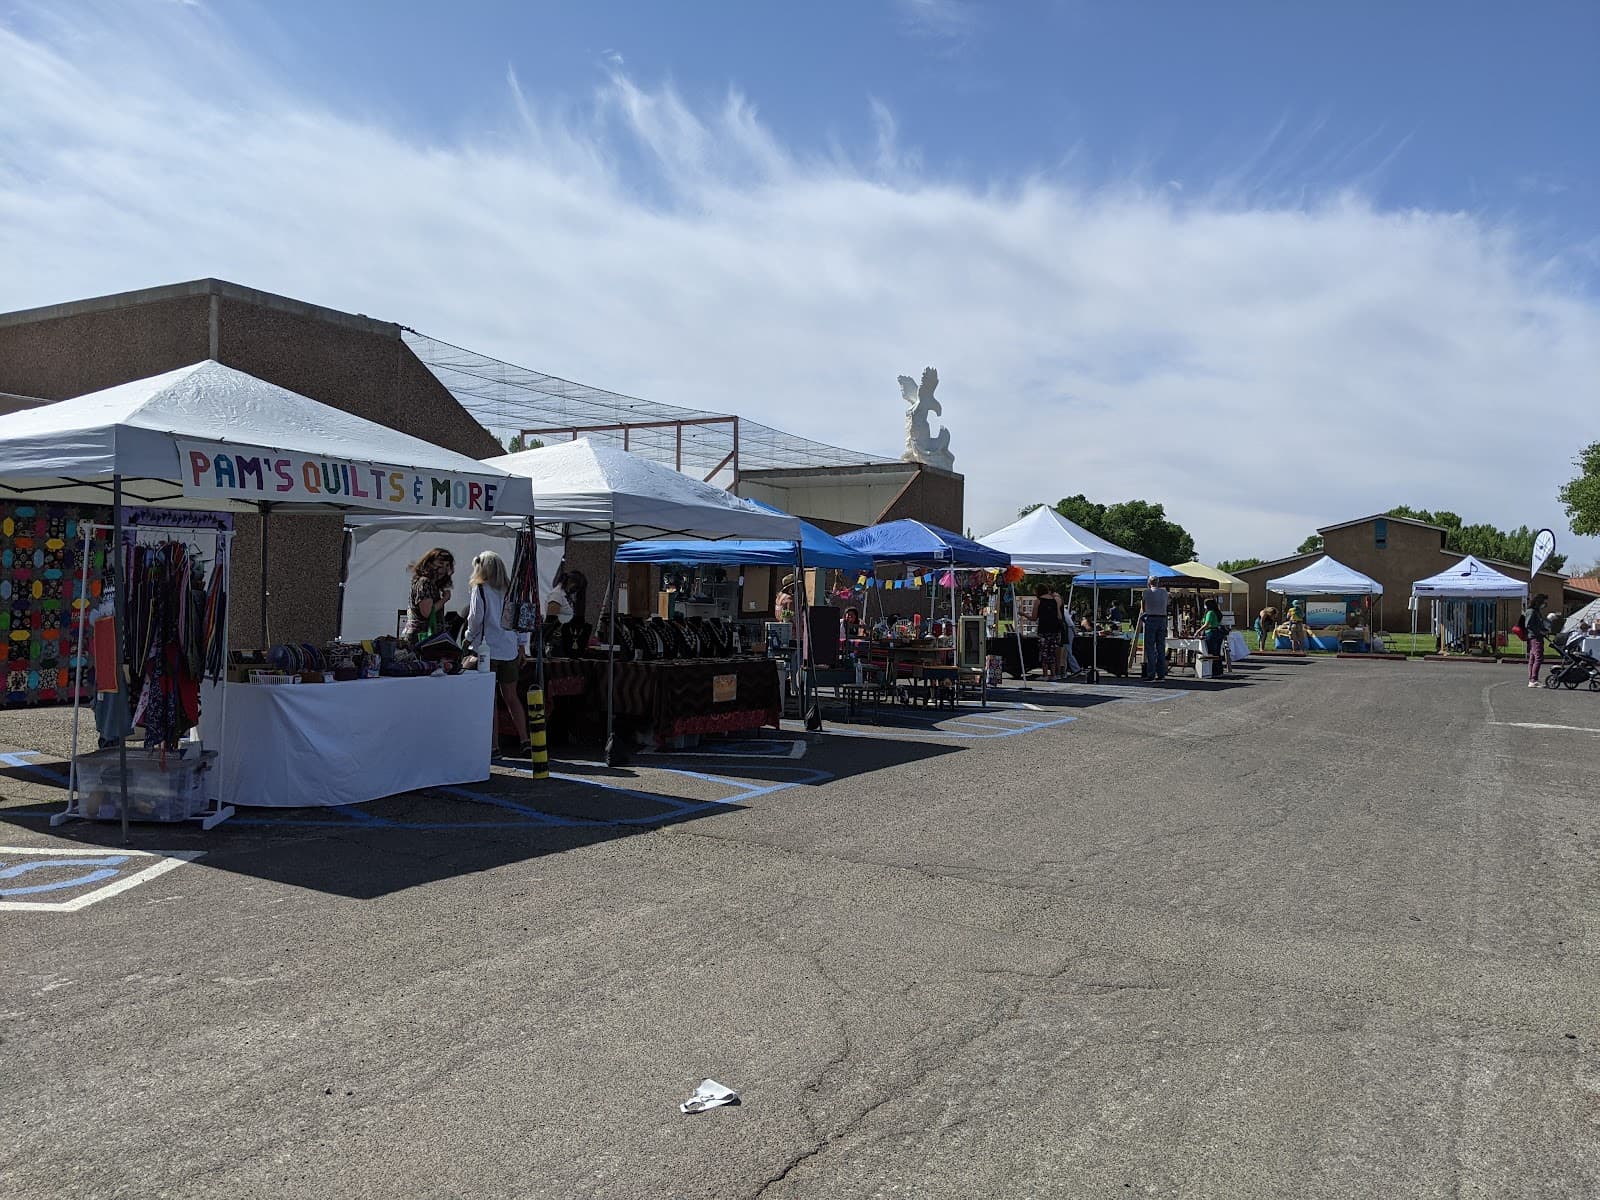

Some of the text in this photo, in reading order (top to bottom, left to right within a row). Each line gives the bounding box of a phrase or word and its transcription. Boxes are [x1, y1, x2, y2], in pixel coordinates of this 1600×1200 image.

[189, 450, 294, 492] PAM'S
[302, 460, 405, 503] QUILTS
[430, 477, 497, 512] MORE
